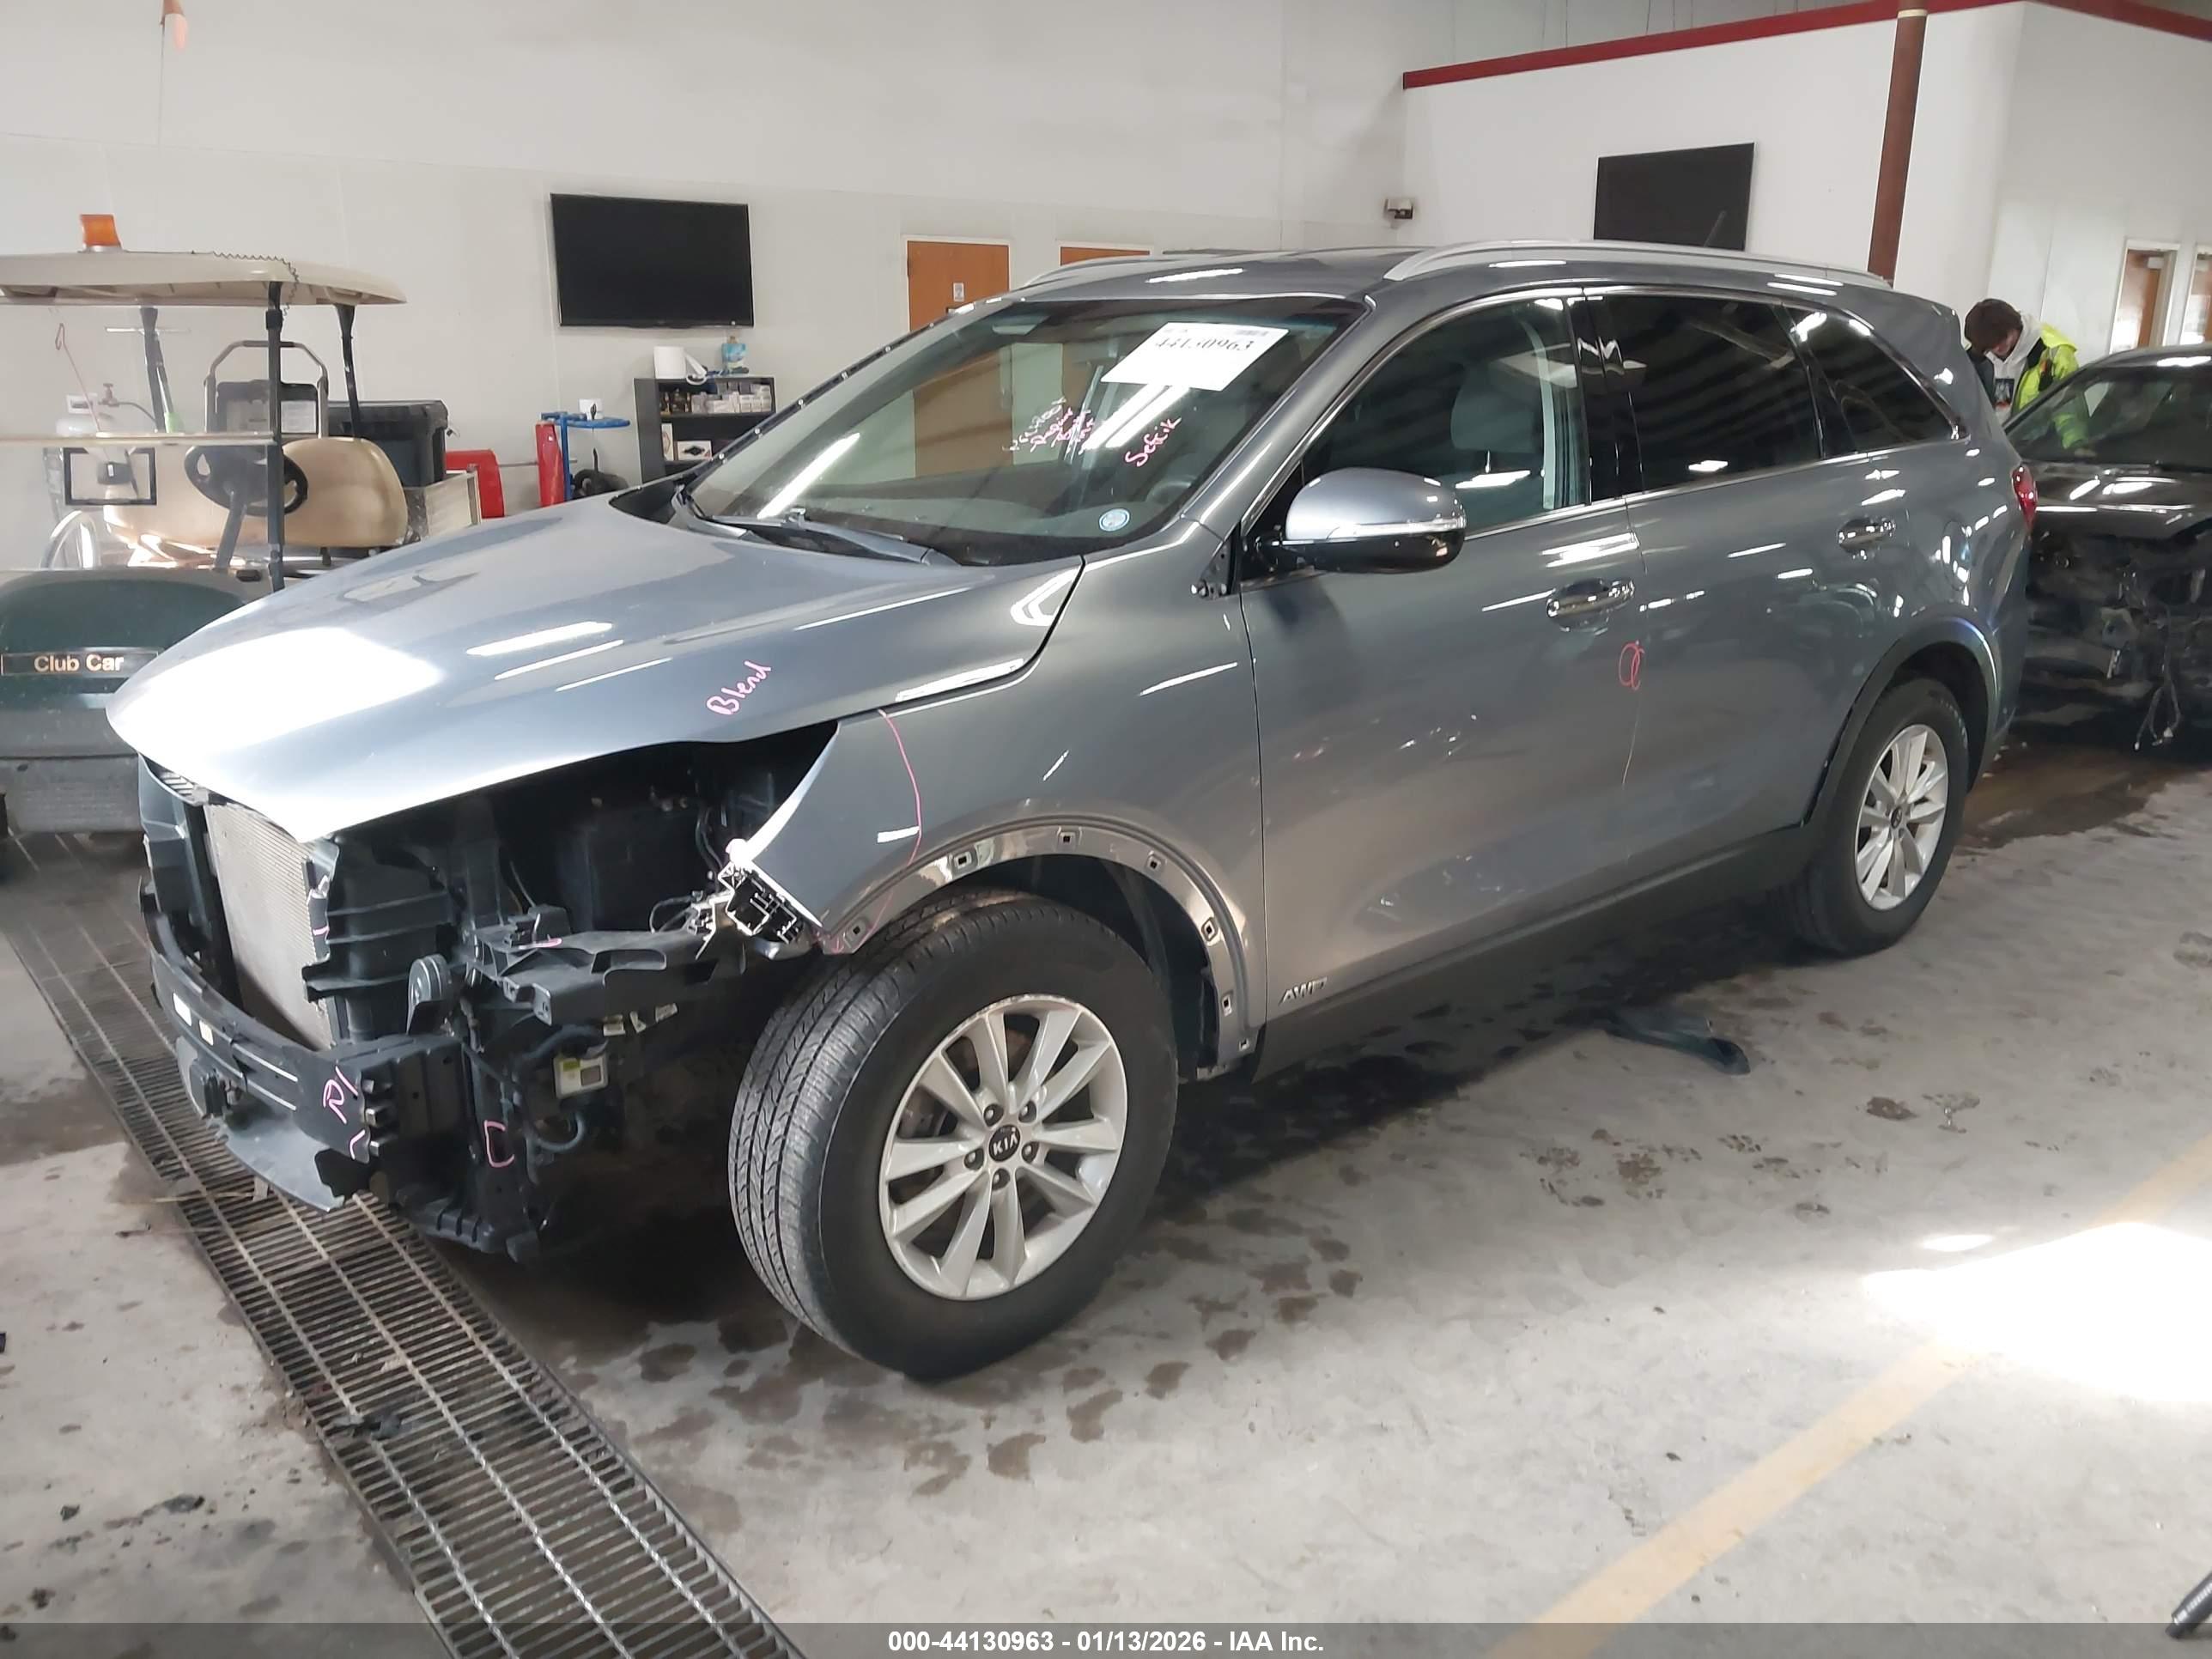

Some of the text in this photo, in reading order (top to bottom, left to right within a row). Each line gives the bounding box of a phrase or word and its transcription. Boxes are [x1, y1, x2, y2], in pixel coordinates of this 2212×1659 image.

[33, 654, 125, 672] Club Car
[706, 660, 772, 715] Blend
[993, 1133, 1018, 1156] KIA
